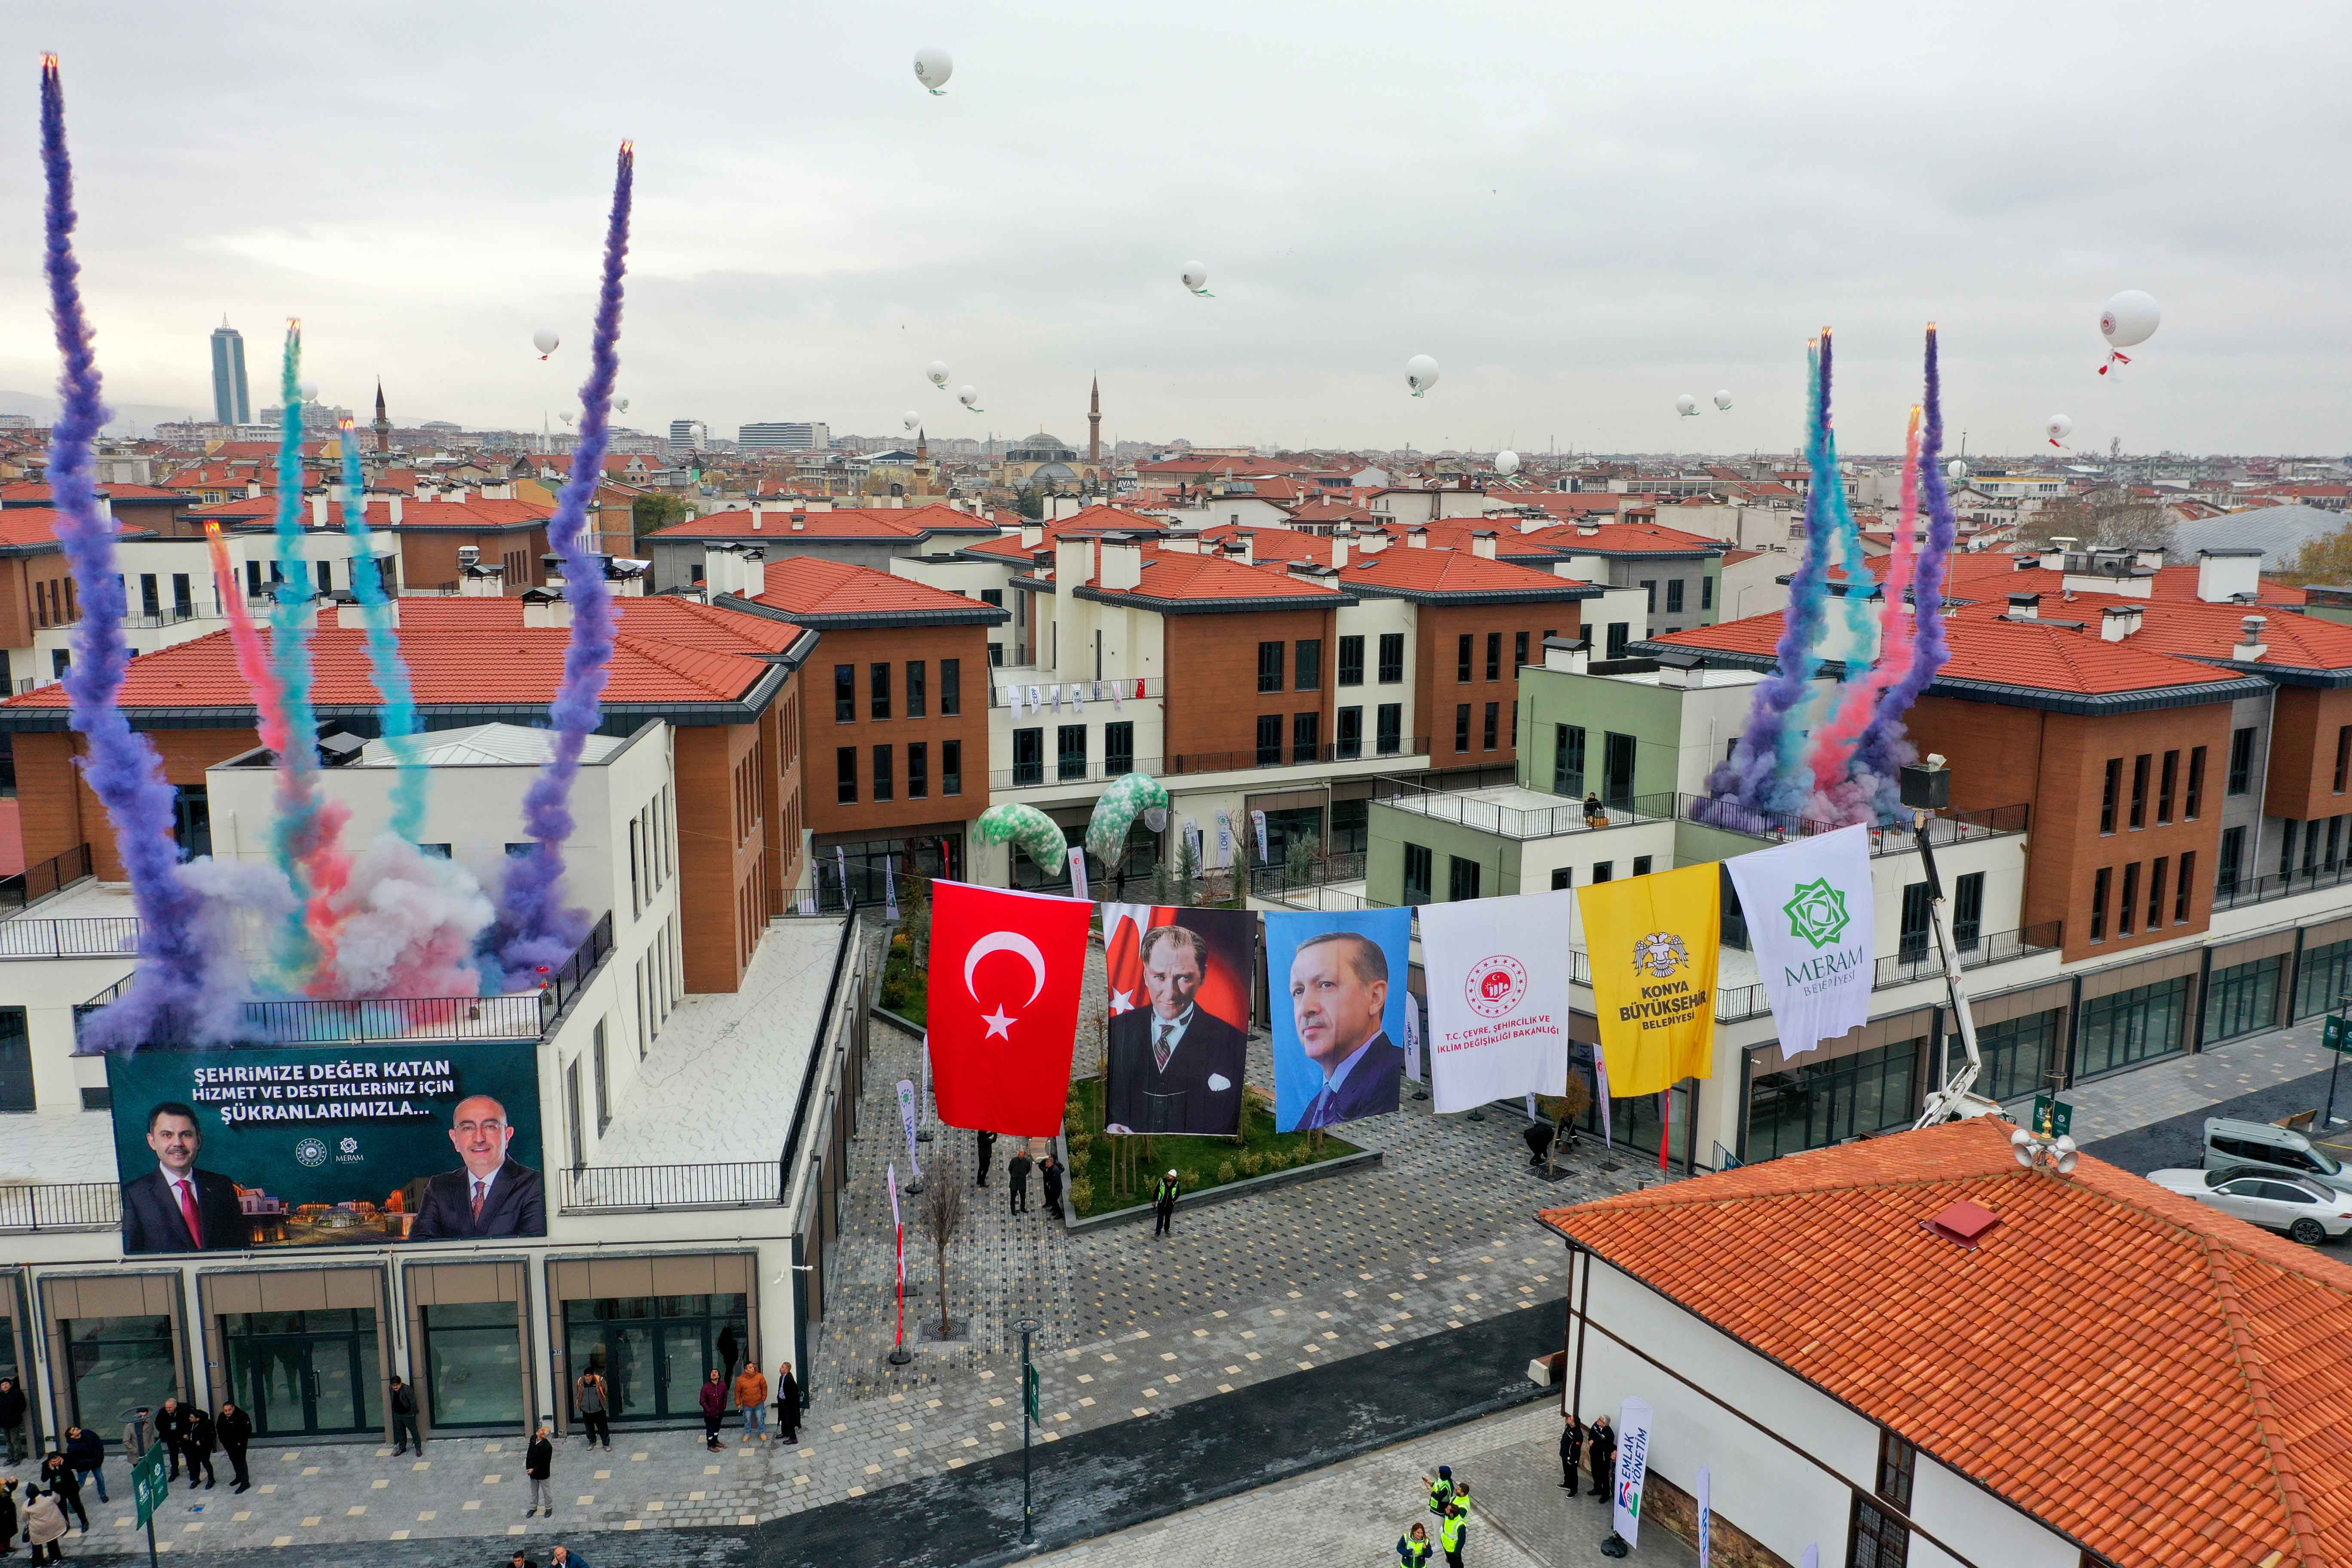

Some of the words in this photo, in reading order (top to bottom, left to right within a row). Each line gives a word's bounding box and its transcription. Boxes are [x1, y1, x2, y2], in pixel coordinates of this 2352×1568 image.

[1785, 945, 1862, 987] MERAM
[1642, 980, 1689, 998] KONYA
[1620, 990, 1706, 1021] BÜYÜKŞEHİR
[1463, 1026, 1491, 1039] ÇEVRE,
[1493, 1016, 1537, 1032] ŞEHİRCİLİK
[1642, 1010, 1694, 1030] BELEDİYESİ
[1437, 1043, 1461, 1053] İKLİM
[1464, 1031, 1511, 1049] DEĞİŞİKLİĞİ
[1513, 1026, 1559, 1038] BAKANLIĞI
[310, 1060, 378, 1080] DEĞER
[383, 1060, 450, 1077] KATAN
[260, 1086, 282, 1098] VE
[220, 1101, 429, 1124] ŞÜKRANLARIMIZLA...
[1622, 1433, 1633, 1479] EMLAK
[1632, 1427, 1647, 1486] YÖNETİM
